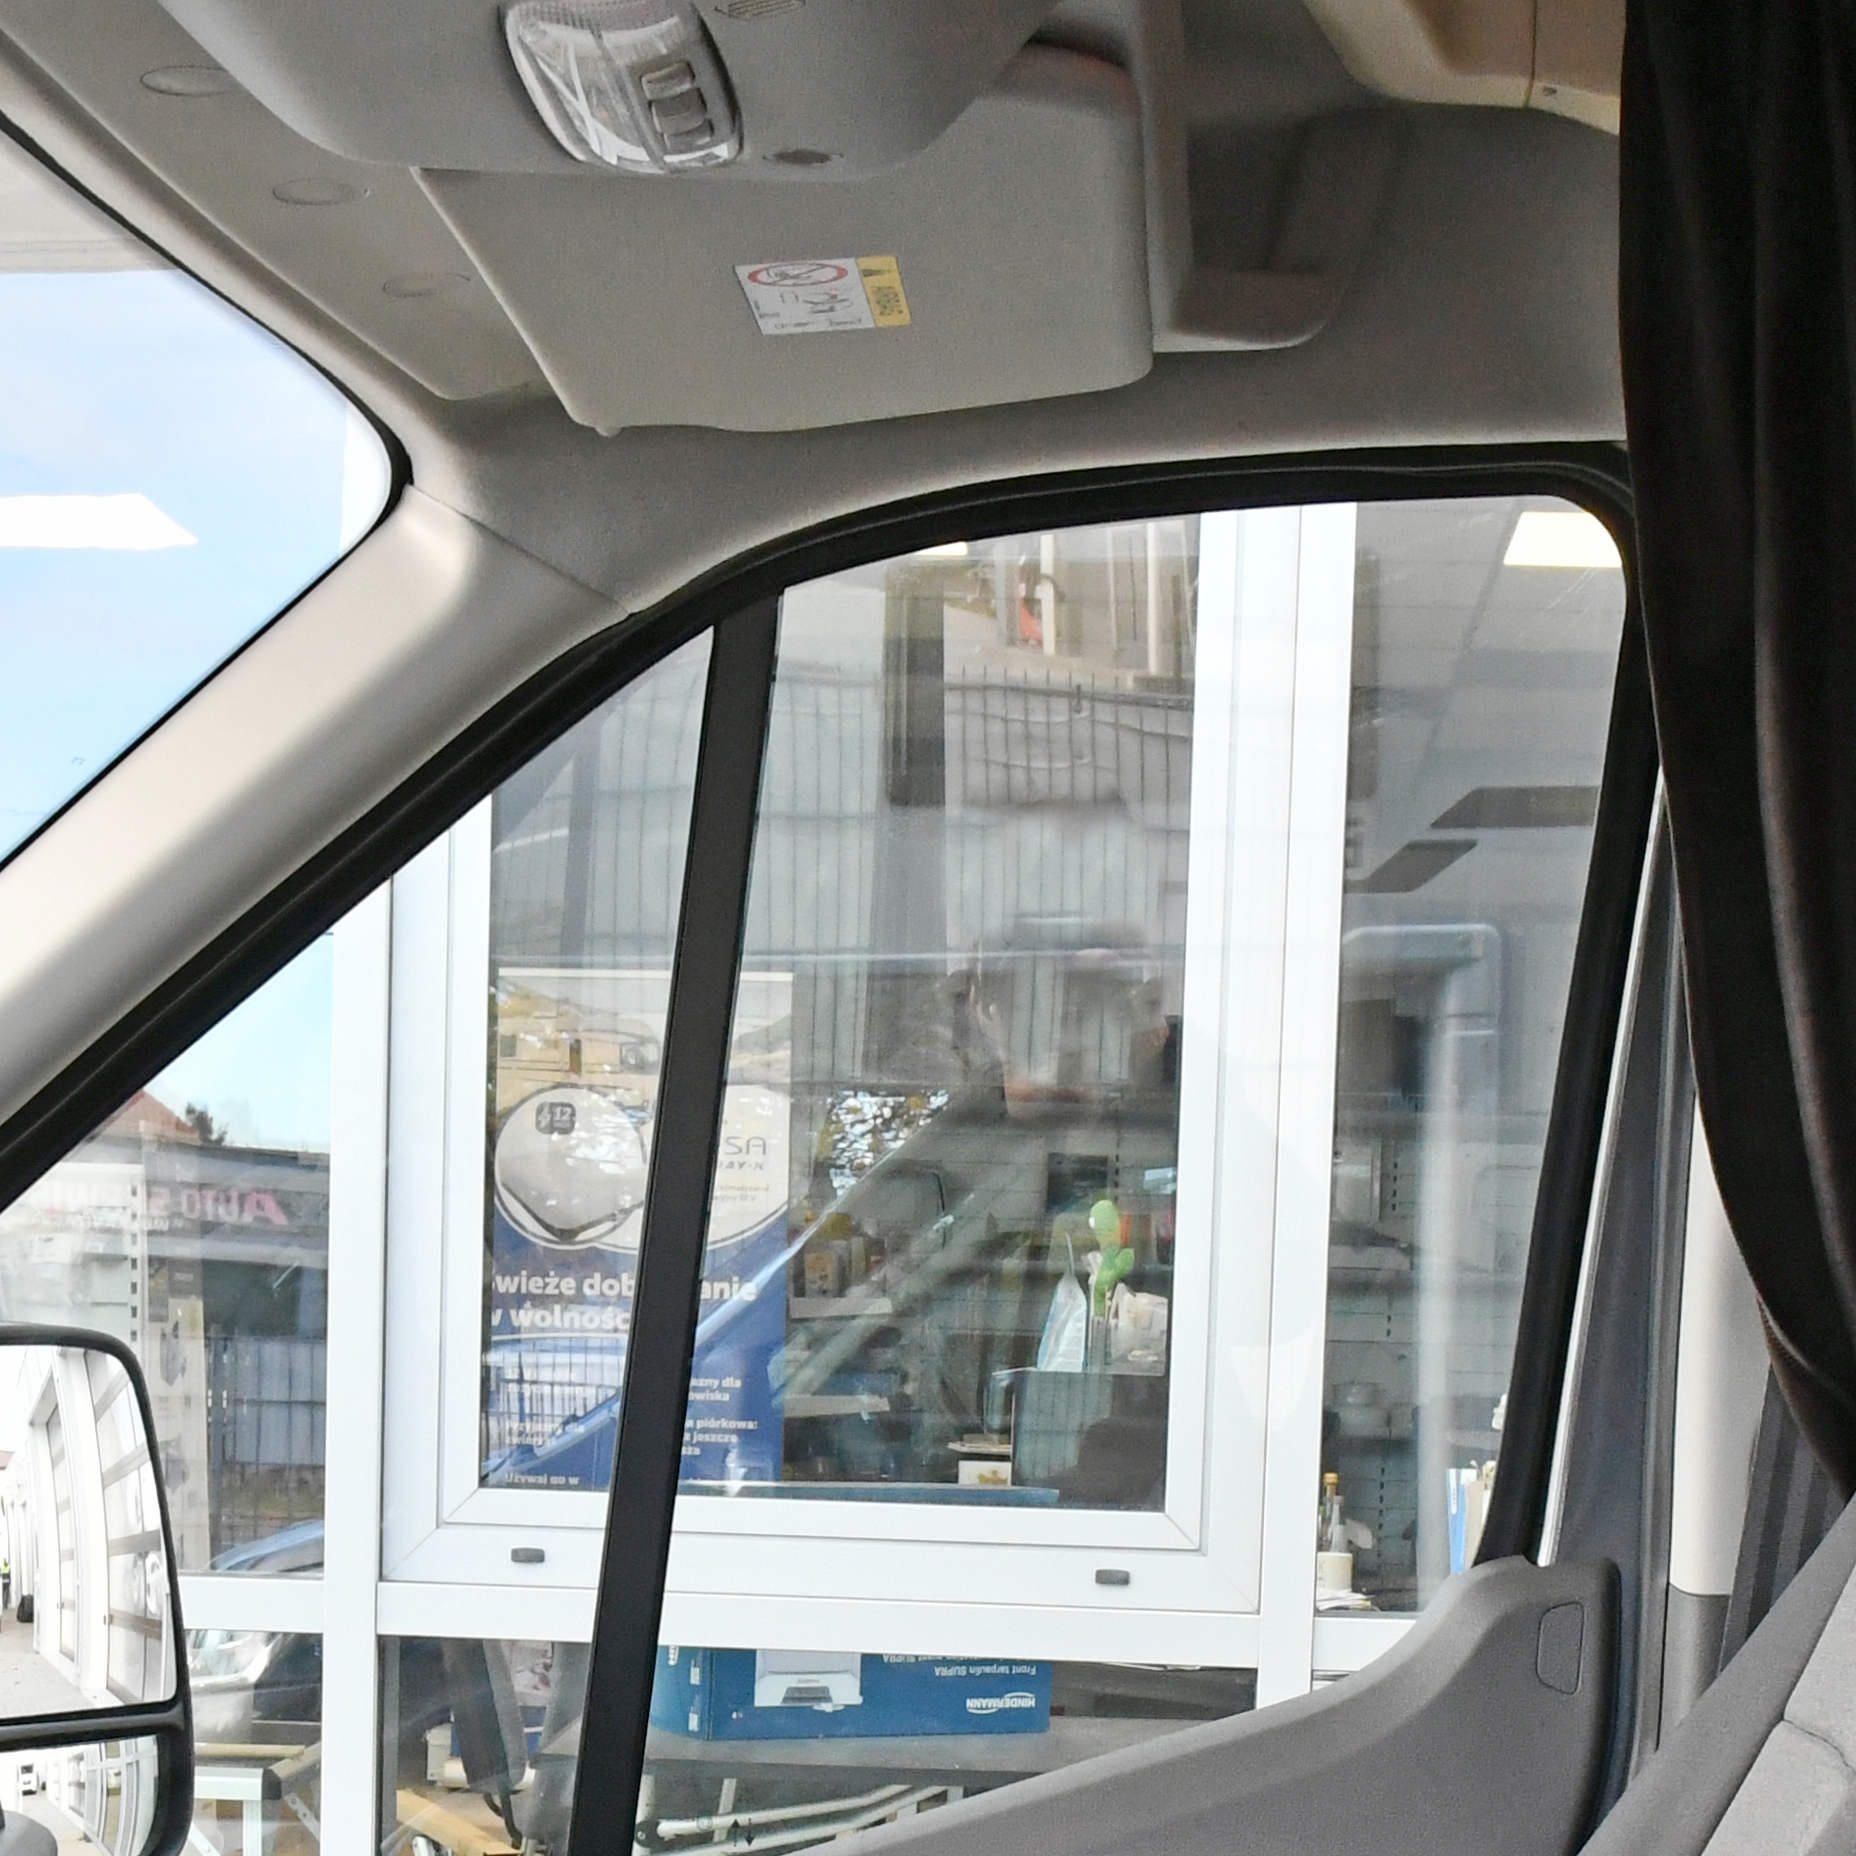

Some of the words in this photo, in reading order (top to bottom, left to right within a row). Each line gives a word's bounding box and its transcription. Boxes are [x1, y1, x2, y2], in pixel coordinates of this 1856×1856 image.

[724, 1135, 767, 1156] SA
[491, 1270, 576, 1296] wieże
[582, 1272, 635, 1297] dob
[700, 1275, 758, 1301] anie
[510, 1303, 631, 1330] wolnośc
[721, 1376, 742, 1388] dla
[688, 1390, 731, 1402] owiska
[934, 1665, 967, 1677] SUPRA
[1011, 1664, 1037, 1676] Front
[965, 1695, 1036, 1711] HINDERMANN
